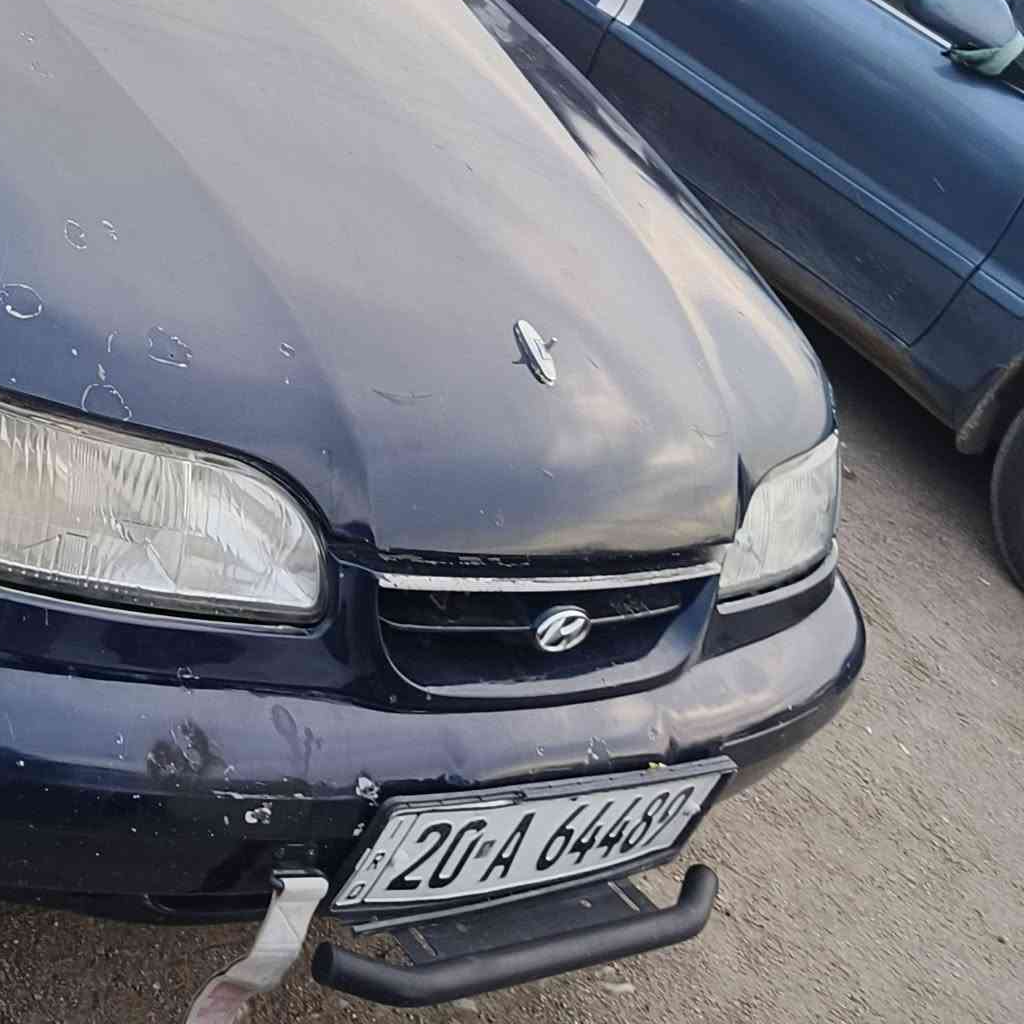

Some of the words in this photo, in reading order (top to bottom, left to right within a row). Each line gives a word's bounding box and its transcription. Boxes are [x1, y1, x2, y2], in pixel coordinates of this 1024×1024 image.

[386, 818, 488, 891] 20
[479, 812, 537, 882] A
[535, 785, 695, 871] 64489
